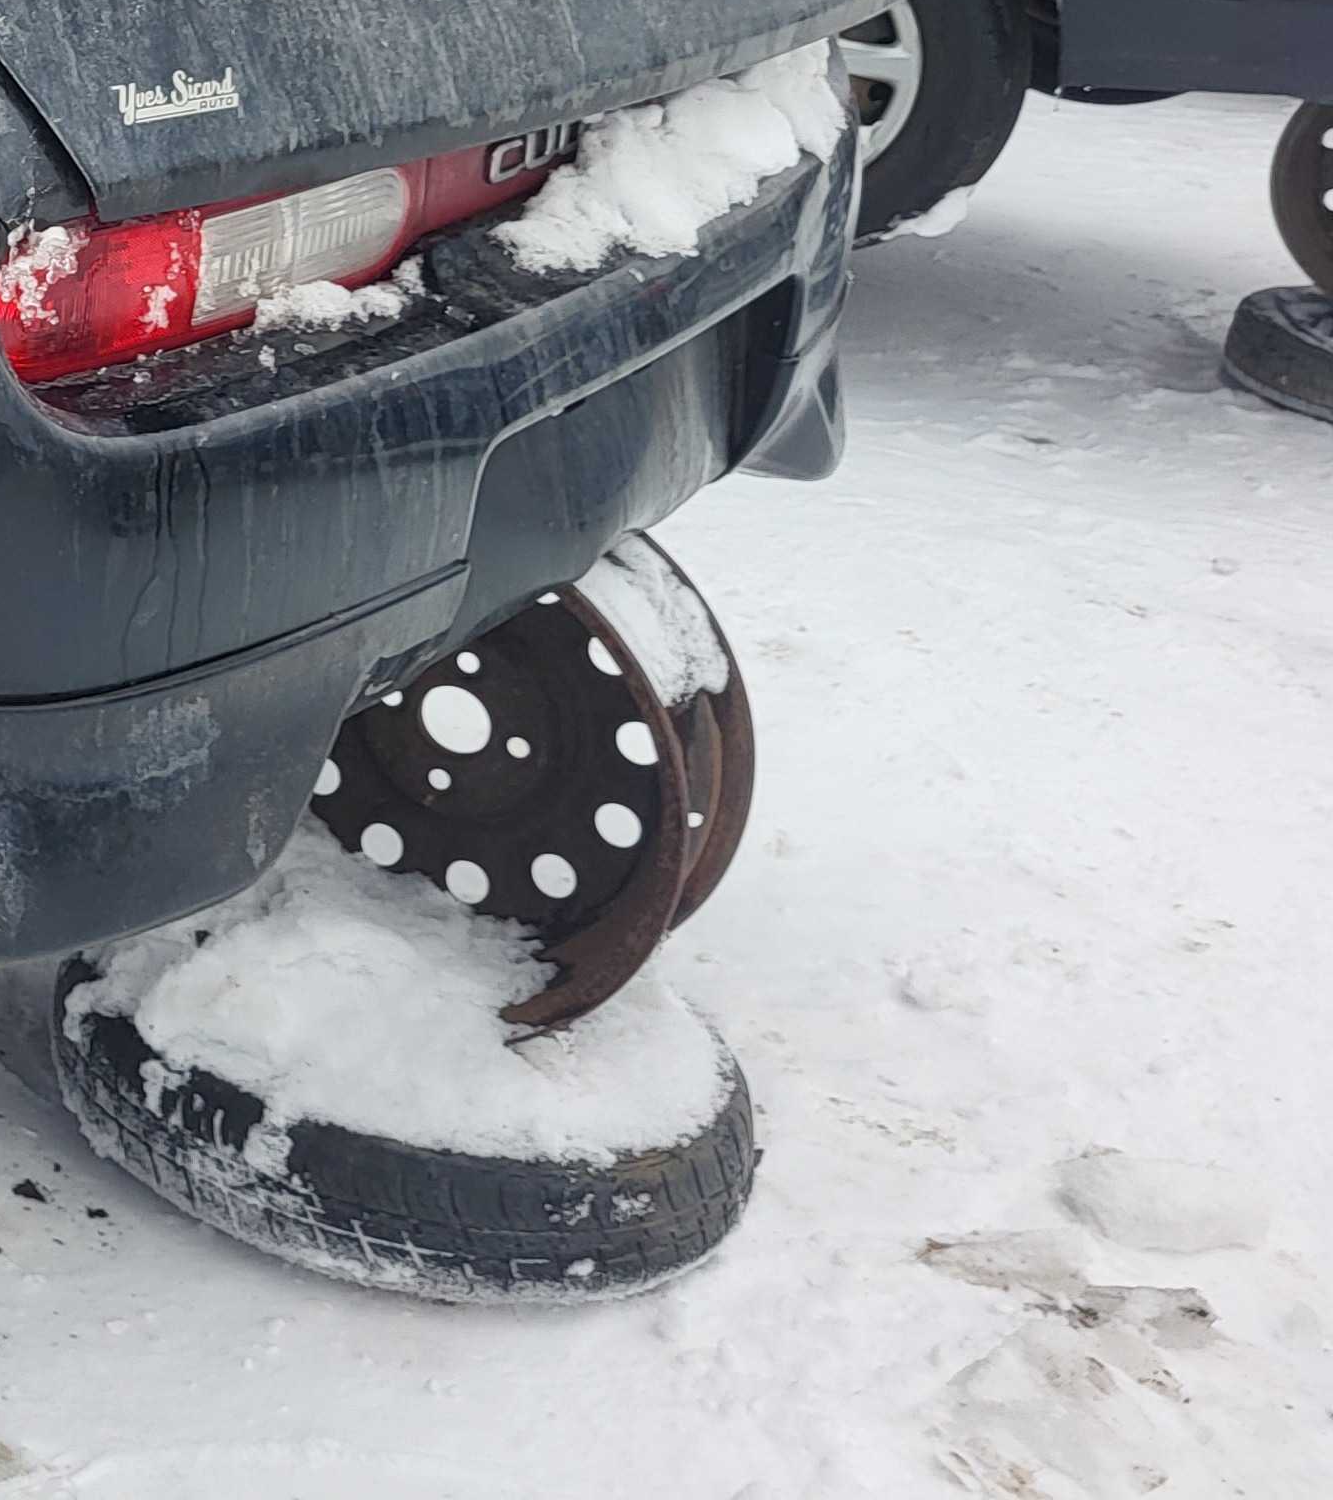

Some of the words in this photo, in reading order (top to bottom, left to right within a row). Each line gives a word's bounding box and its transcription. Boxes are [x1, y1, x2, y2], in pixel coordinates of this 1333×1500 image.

[109, 82, 168, 126] Yves
[170, 66, 236, 108] Sicard
[199, 96, 235, 109] AUTO
